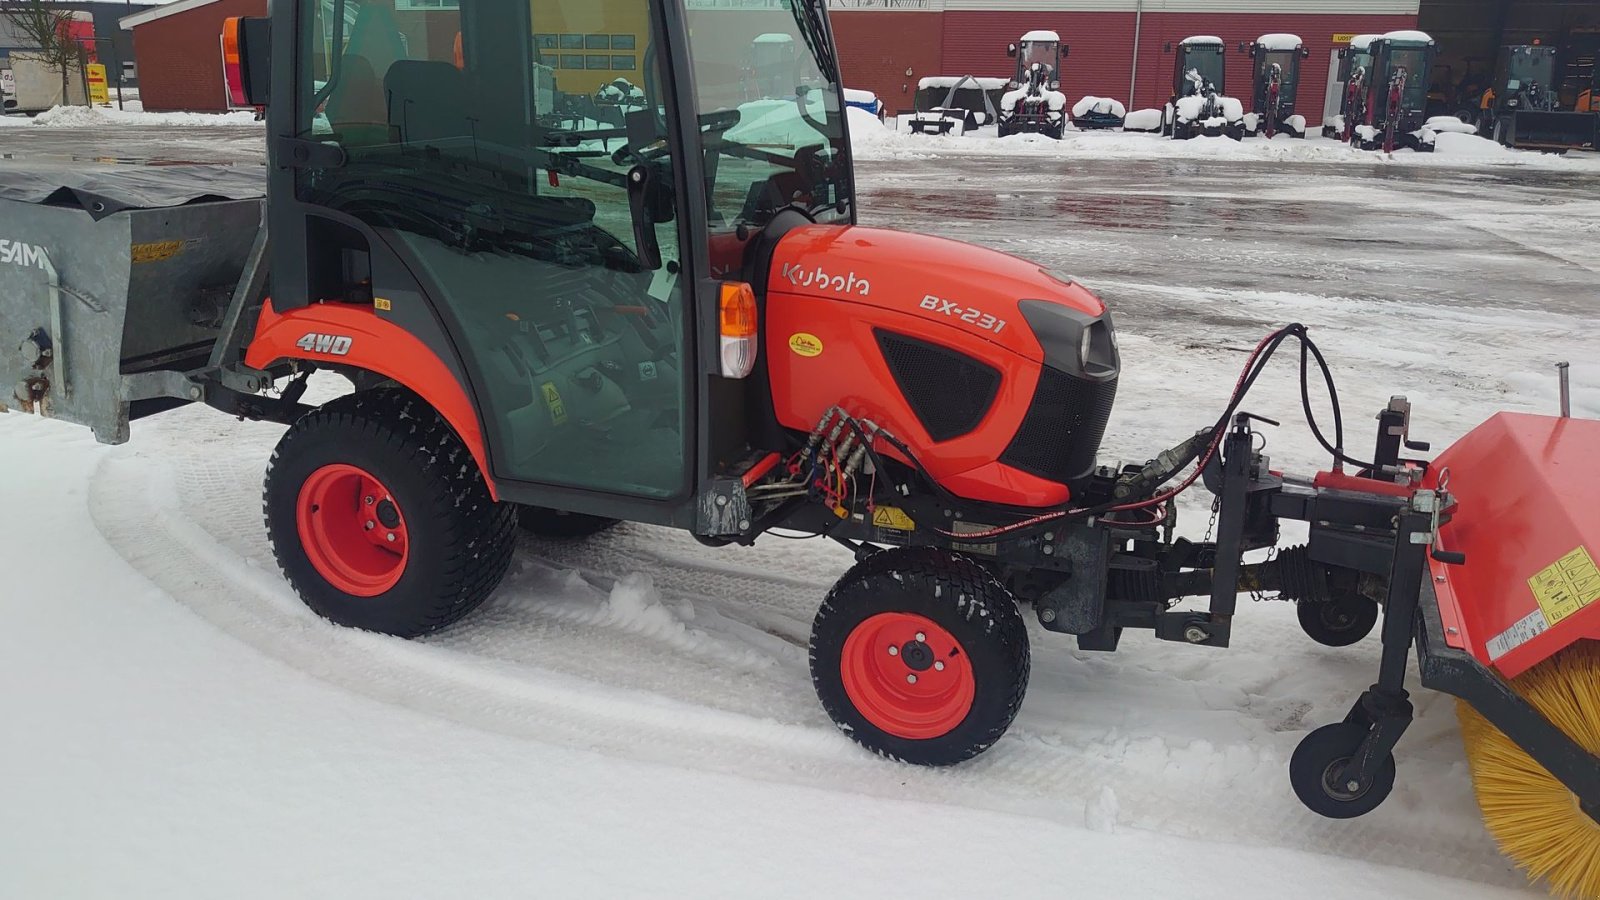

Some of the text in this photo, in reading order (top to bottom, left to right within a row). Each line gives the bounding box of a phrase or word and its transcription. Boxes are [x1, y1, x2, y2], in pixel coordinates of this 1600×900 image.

[0, 239, 50, 270] SAM
[782, 262, 870, 295] Kubota
[919, 295, 1006, 334] BX-231
[296, 333, 352, 355] 4WD
